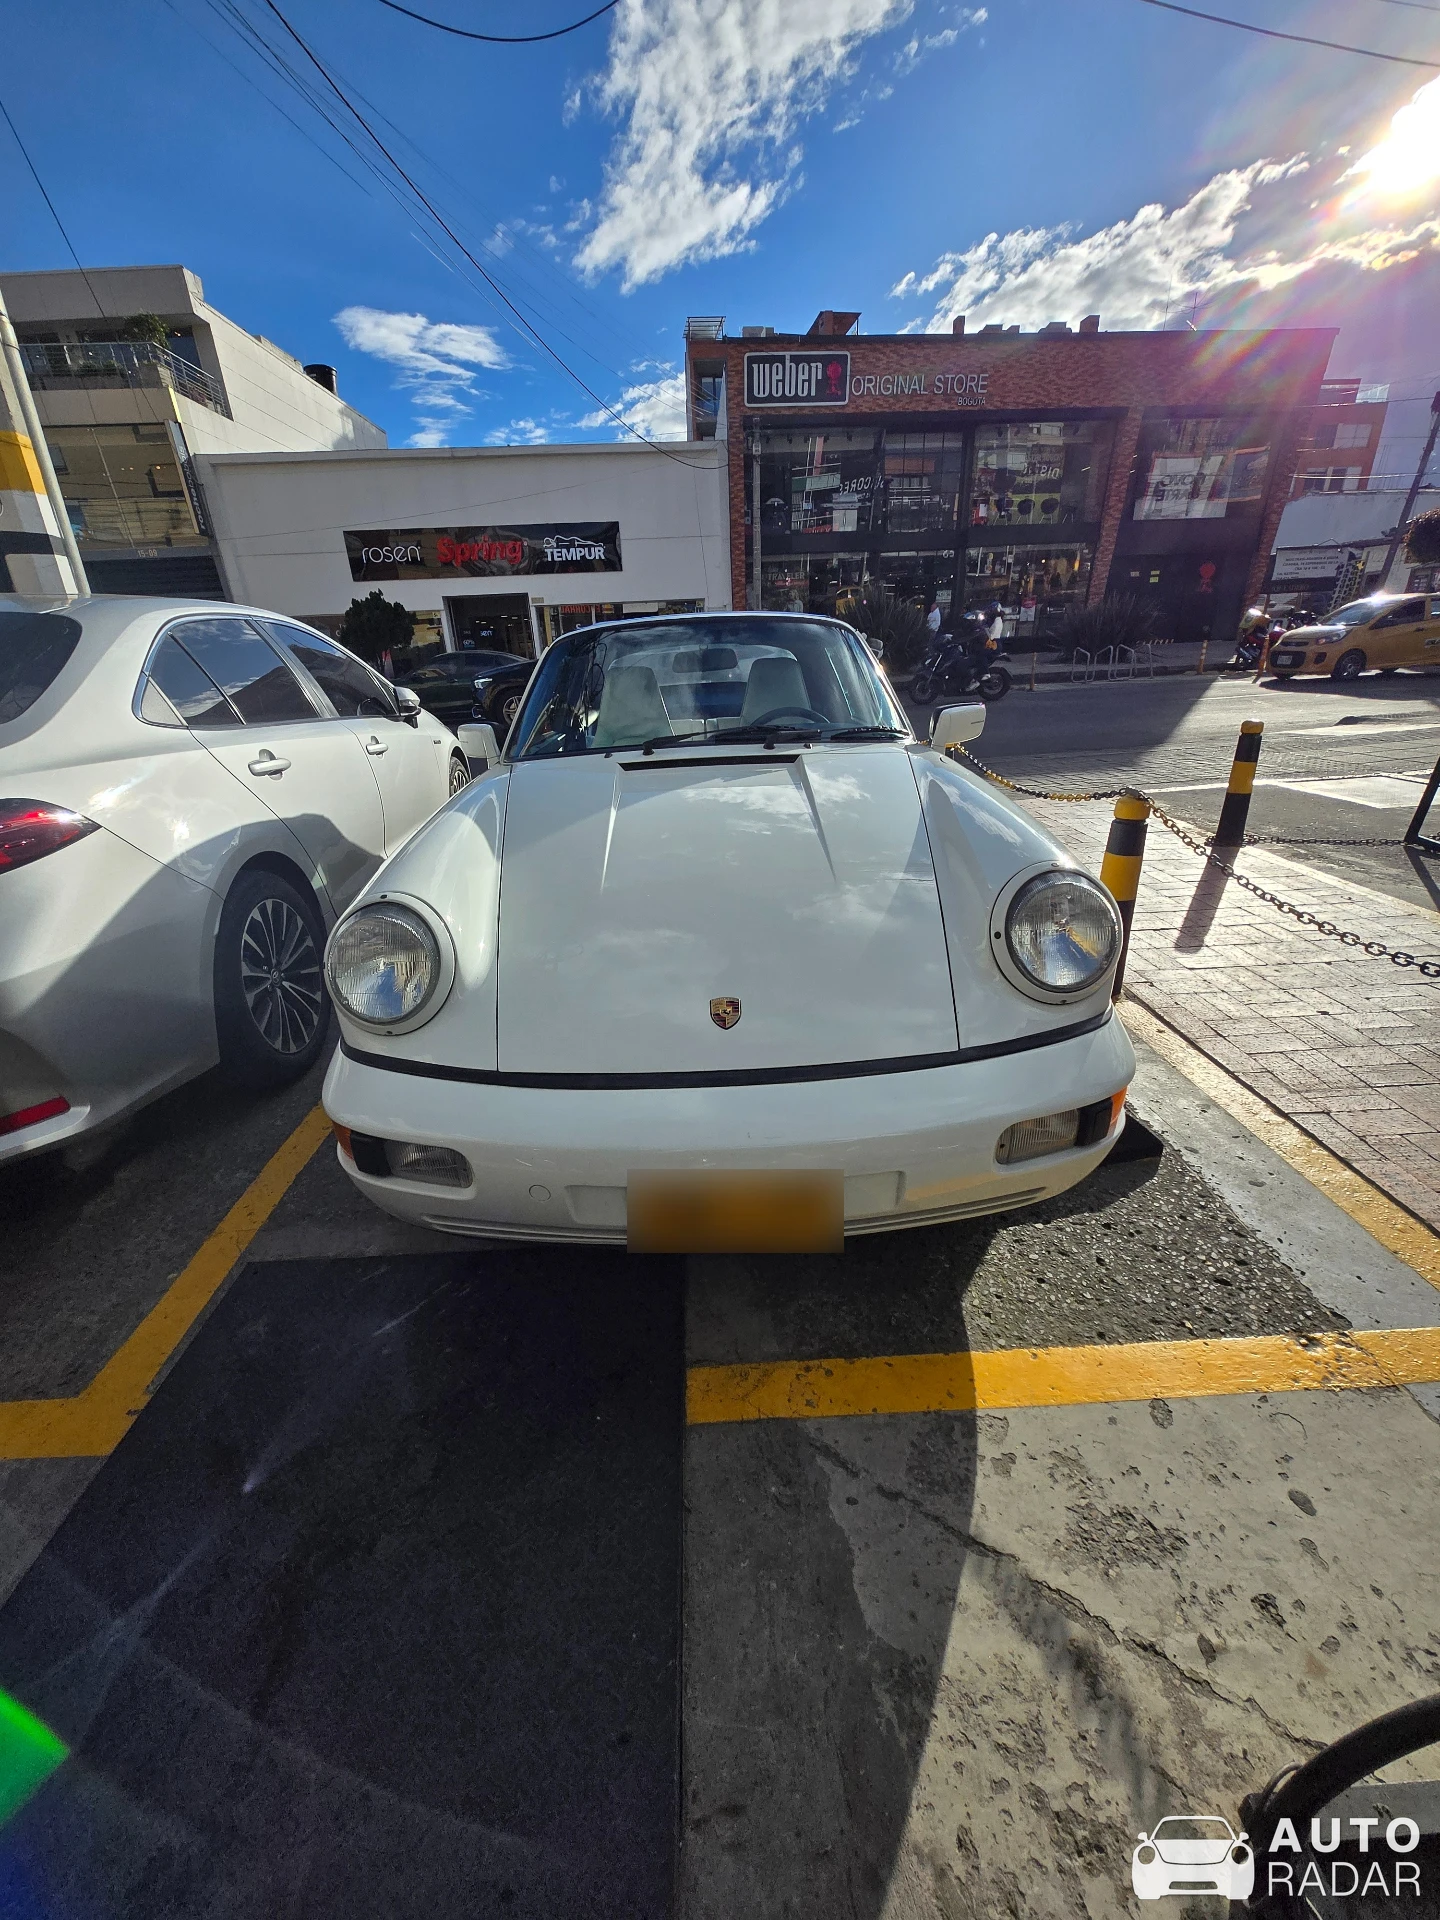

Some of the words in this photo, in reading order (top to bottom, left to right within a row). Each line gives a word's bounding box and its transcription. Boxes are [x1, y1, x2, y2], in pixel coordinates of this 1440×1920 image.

[752, 354, 823, 398] weber
[851, 374, 929, 396] ORIGINAL
[933, 373, 989, 394] STORE
[361, 545, 421, 564] rosen
[436, 535, 522, 567] Spring
[545, 546, 605, 562] TEMPUR
